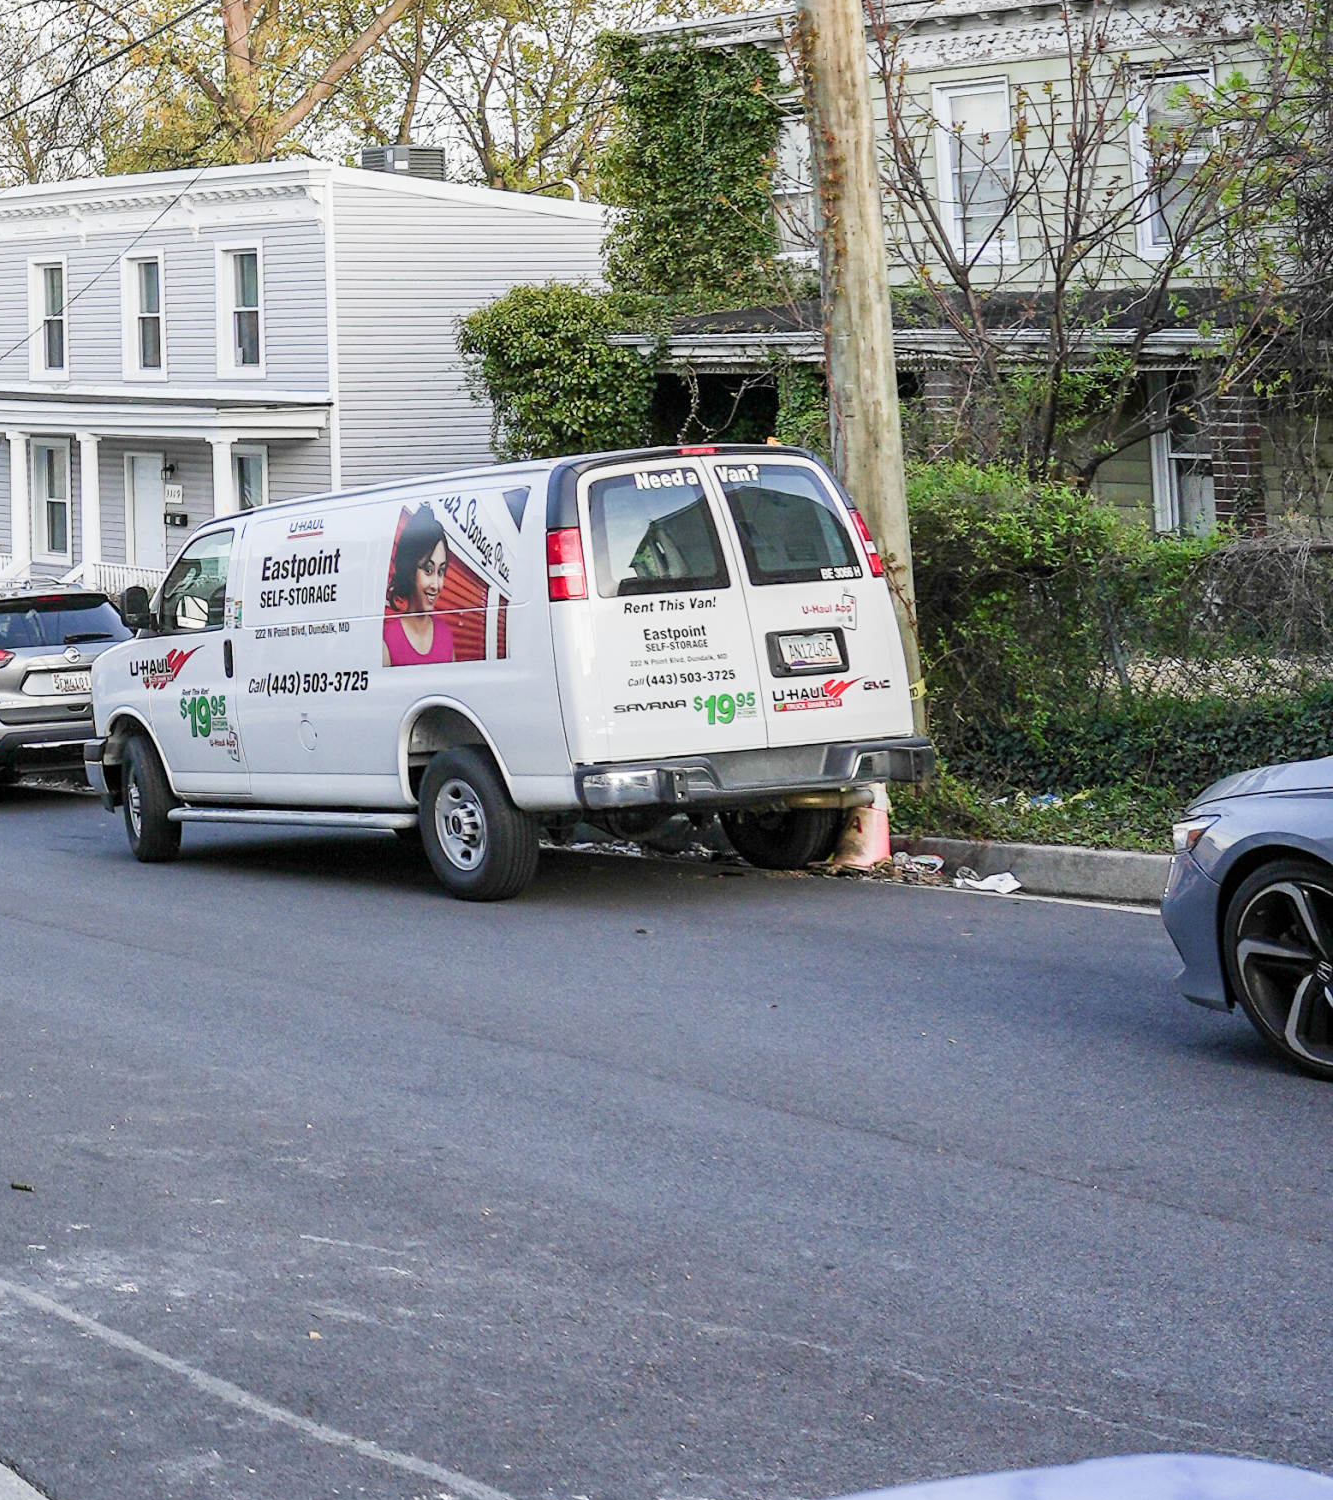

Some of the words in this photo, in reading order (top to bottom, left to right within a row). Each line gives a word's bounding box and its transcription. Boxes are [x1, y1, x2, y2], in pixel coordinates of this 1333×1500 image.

[633, 468, 685, 490] Need
[685, 471, 699, 486] a
[714, 464, 759, 483] Van?
[289, 518, 324, 534] U-HAUL
[460, 499, 492, 567] Storage
[261, 548, 341, 583] Eastpoint
[820, 568, 834, 580] BE
[853, 565, 862, 577] H
[259, 584, 337, 609] SELF-STORAGE
[624, 601, 654, 614] Rent
[659, 599, 685, 612] This
[689, 596, 717, 609] Van!
[801, 604, 832, 615] U-Haul
[835, 603, 852, 614] App
[255, 628, 266, 640] 222
[643, 624, 707, 641] Eastpoint
[645, 638, 709, 653] SELF-STORAGE
[130, 658, 171, 677] U-HAUL
[249, 677, 266, 694] Call
[267, 673, 300, 697] (443)
[303, 671, 369, 694] 503-3725
[628, 678, 645, 687] Call
[646, 674, 678, 687] (443)
[680, 669, 736, 684] 503-3725
[863, 679, 891, 690] GMC
[772, 686, 828, 702] U-HAUL
[613, 699, 687, 714] SAVANA
